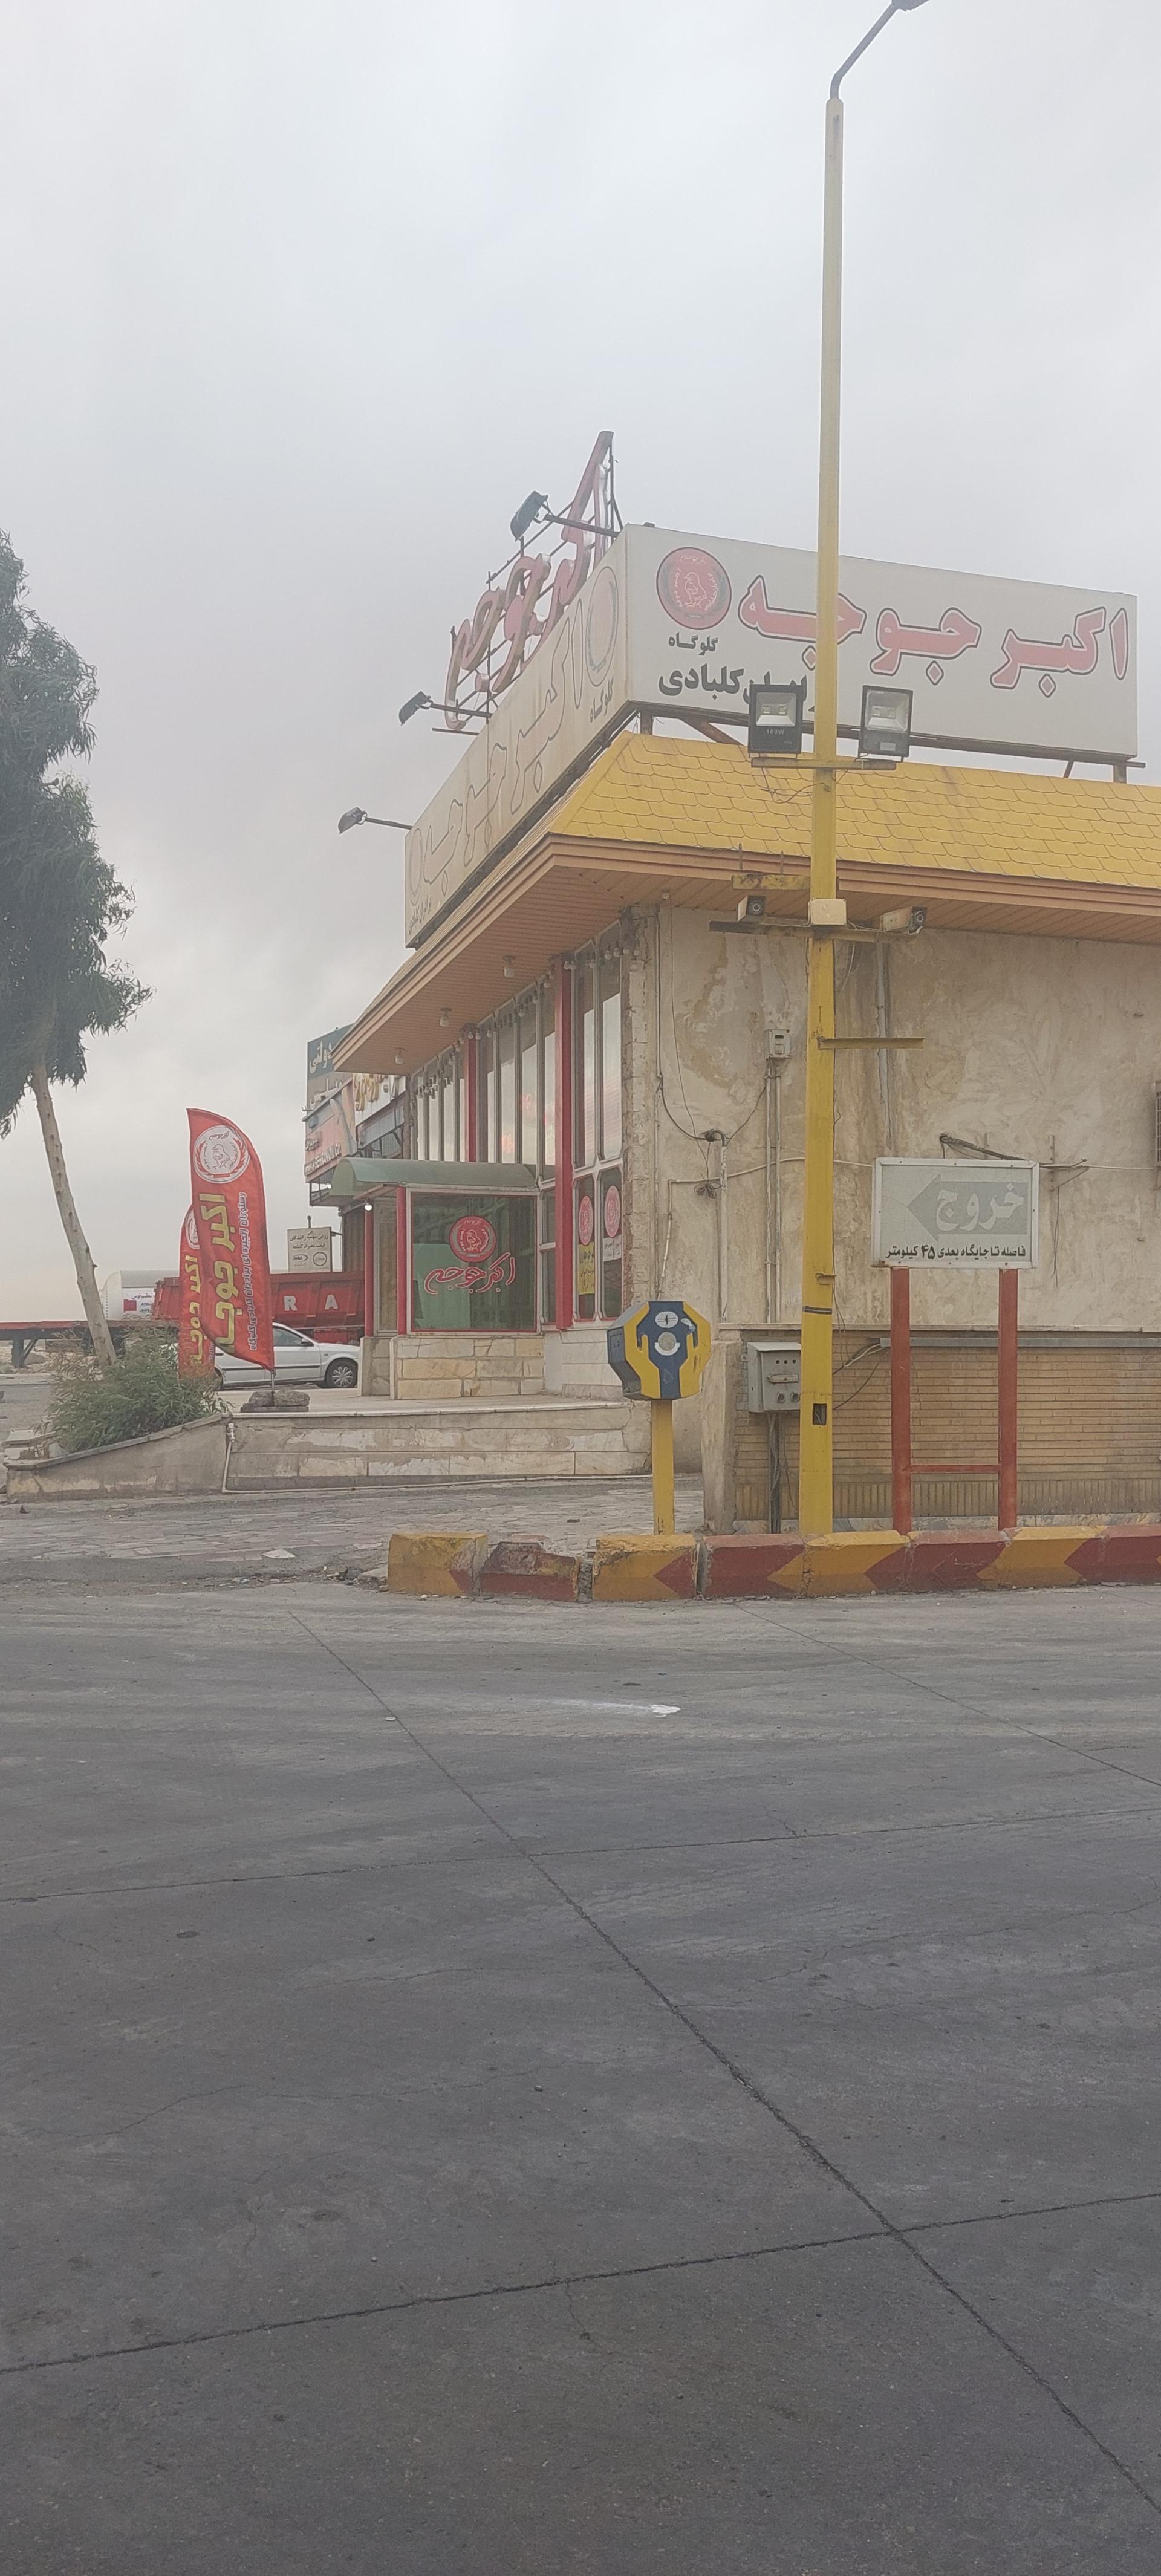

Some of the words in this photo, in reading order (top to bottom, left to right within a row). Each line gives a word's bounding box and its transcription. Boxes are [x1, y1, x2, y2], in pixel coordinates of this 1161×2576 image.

[668, 632, 718, 655] گلوگاه
[738, 574, 983, 686] جوجه
[989, 607, 1128, 698] اکبر
[659, 663, 744, 700] کلبادی
[511, 597, 584, 815] اکبر
[423, 741, 507, 897] جوجه
[936, 1183, 1024, 1231] خروج
[199, 1193, 236, 1253] اکبر
[885, 1245, 919, 1260] کیلومتر
[921, 1244, 935, 1260] ۴۵
[938, 1246, 960, 1260] بعدی
[961, 1244, 989, 1260] جایگاه
[990, 1246, 1000, 1257] تا
[1001, 1245, 1026, 1257] فاصله
